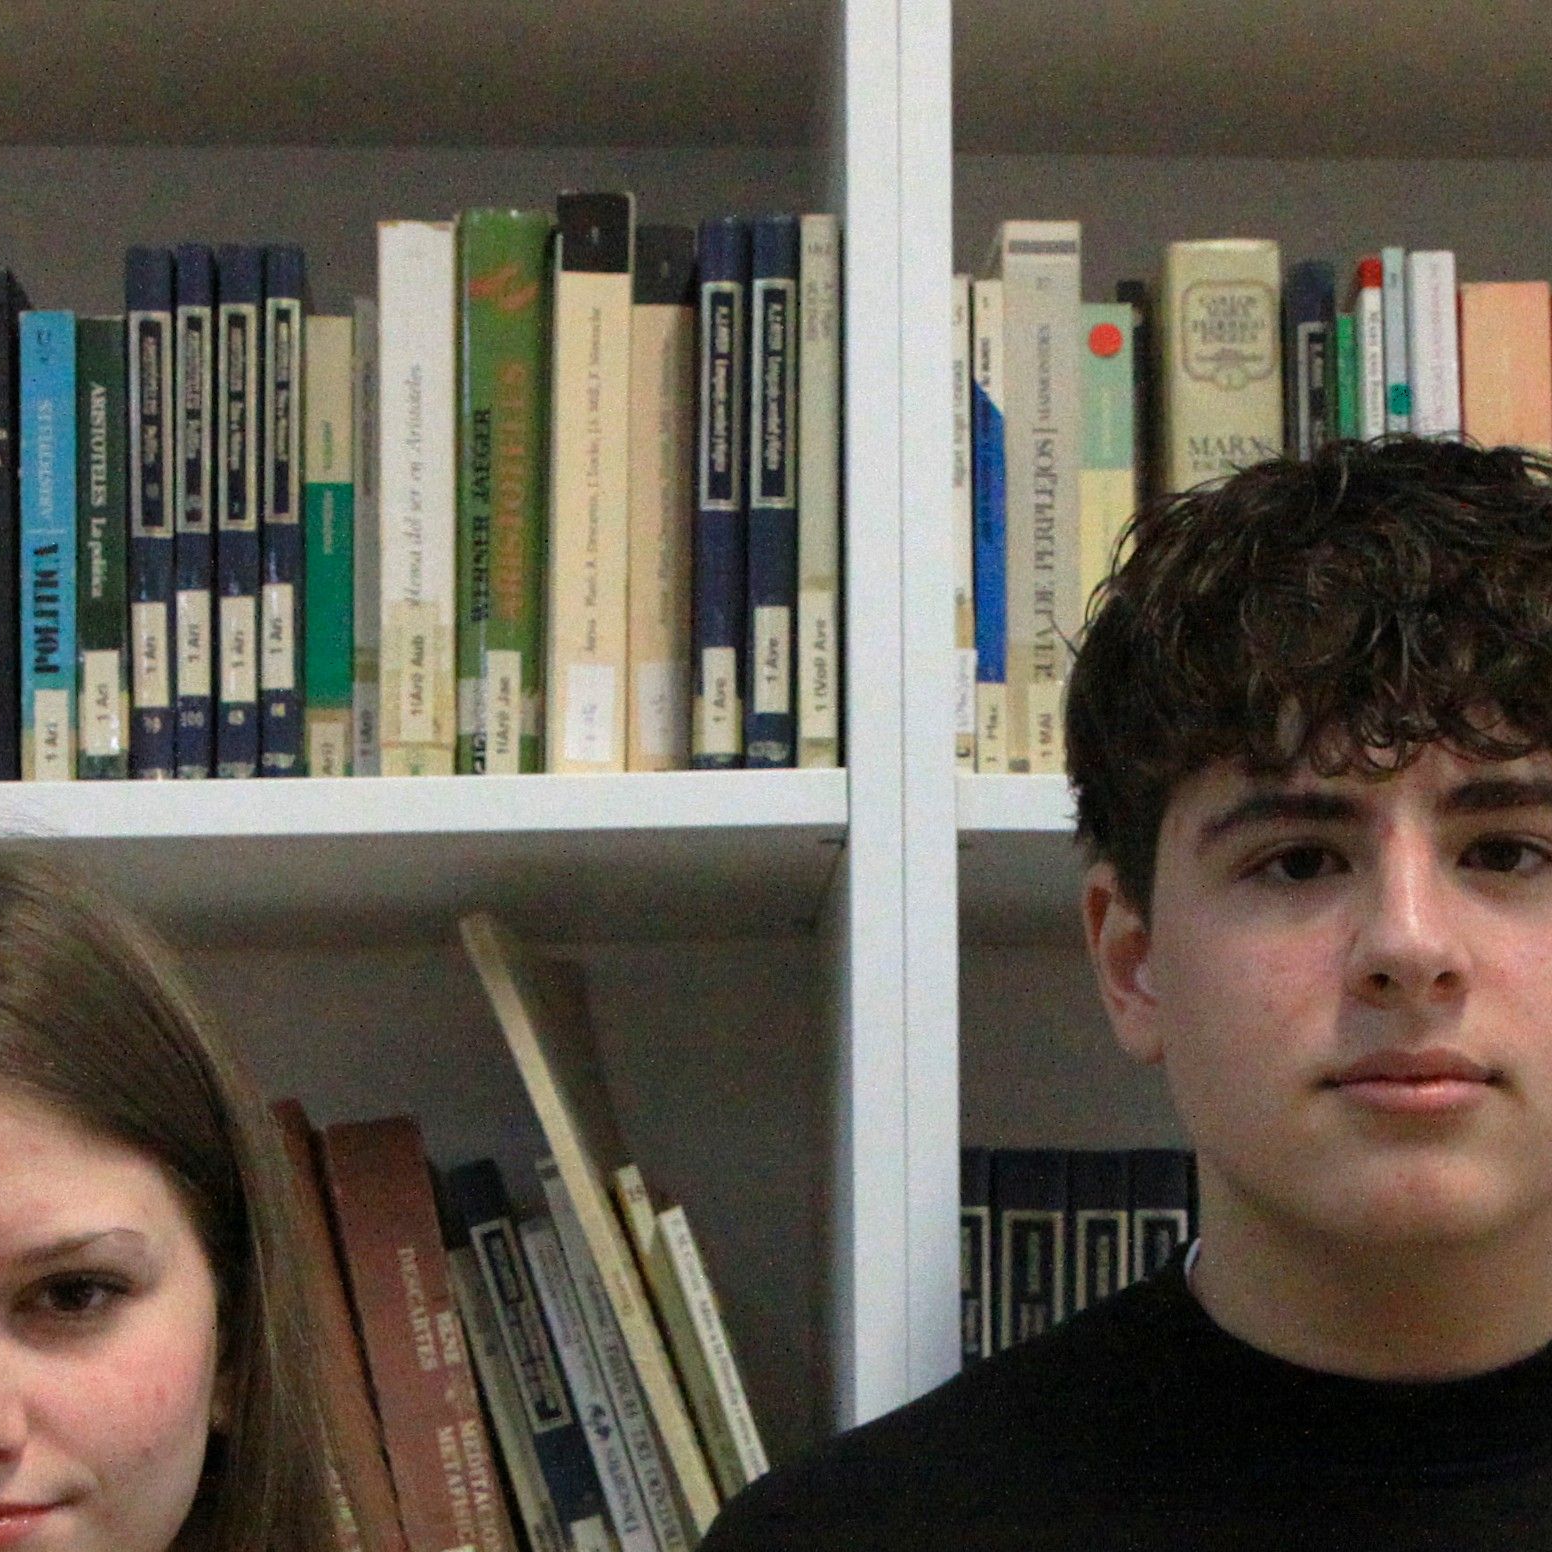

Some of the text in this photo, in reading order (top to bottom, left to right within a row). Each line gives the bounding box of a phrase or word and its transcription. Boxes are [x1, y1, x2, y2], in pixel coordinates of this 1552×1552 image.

[90, 382, 107, 505] ARISTOTELES
[1032, 438, 1057, 571] PERPLEJOS
[92, 517, 106, 535] La
[471, 408, 492, 622] WERNER JAEGER
[1033, 579, 1054, 614] DE
[437, 1425, 474, 1549] METAFISIC
